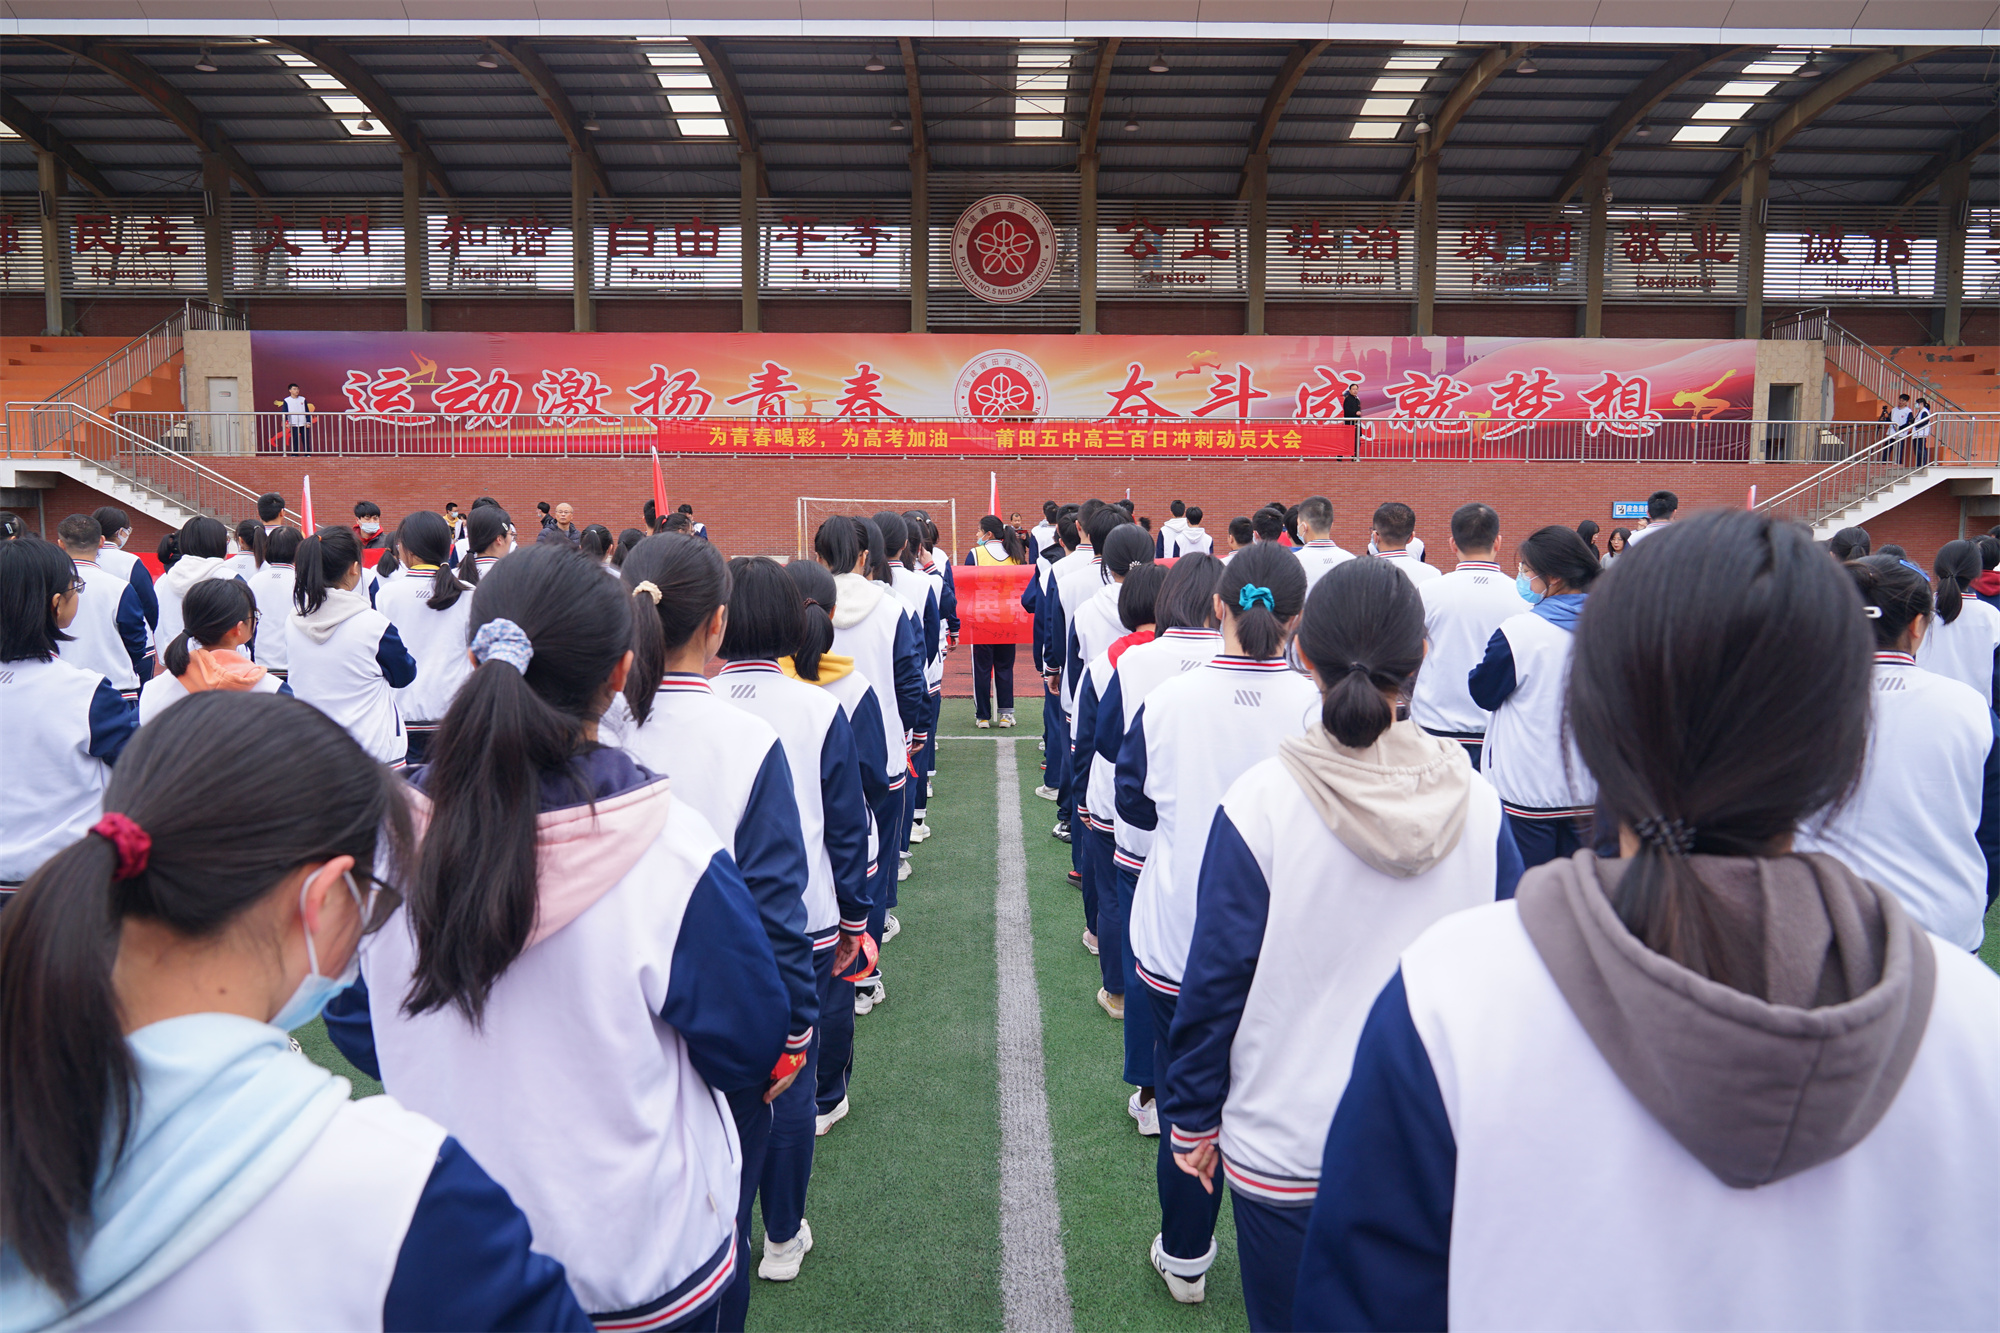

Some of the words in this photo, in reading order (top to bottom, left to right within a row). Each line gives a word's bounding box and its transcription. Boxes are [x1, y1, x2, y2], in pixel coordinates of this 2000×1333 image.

[75, 214, 188, 255] 民主
[252, 214, 371, 256] 文明
[438, 215, 552, 257] 和谐
[609, 215, 719, 257] 自由
[776, 215, 893, 257] 平等
[1115, 217, 1231, 260] 公正
[1286, 219, 1400, 260] 法治
[1455, 221, 1572, 262] 爱国
[1620, 222, 1734, 263] 敬业
[91, 266, 176, 281] Democracy
[461, 268, 534, 282] Harmony
[631, 268, 702, 280] Freedom
[802, 268, 868, 283] Equality
[960, 256, 967, 267] PU
[964, 267, 978, 286] TIAN
[997, 284, 1028, 296] MIDDLE
[1027, 257, 1049, 286] SCHOOL
[1143, 270, 1206, 284] Justice
[1301, 271, 1332, 285] Rule
[1337, 272, 1351, 285] of
[1355, 273, 1384, 285] Law
[1473, 273, 1552, 286] Patriotism
[1636, 275, 1717, 288] Dedication
[342, 360, 917, 428] 运动激扬青春
[1092, 362, 1664, 441] 奋斗成就梦想
